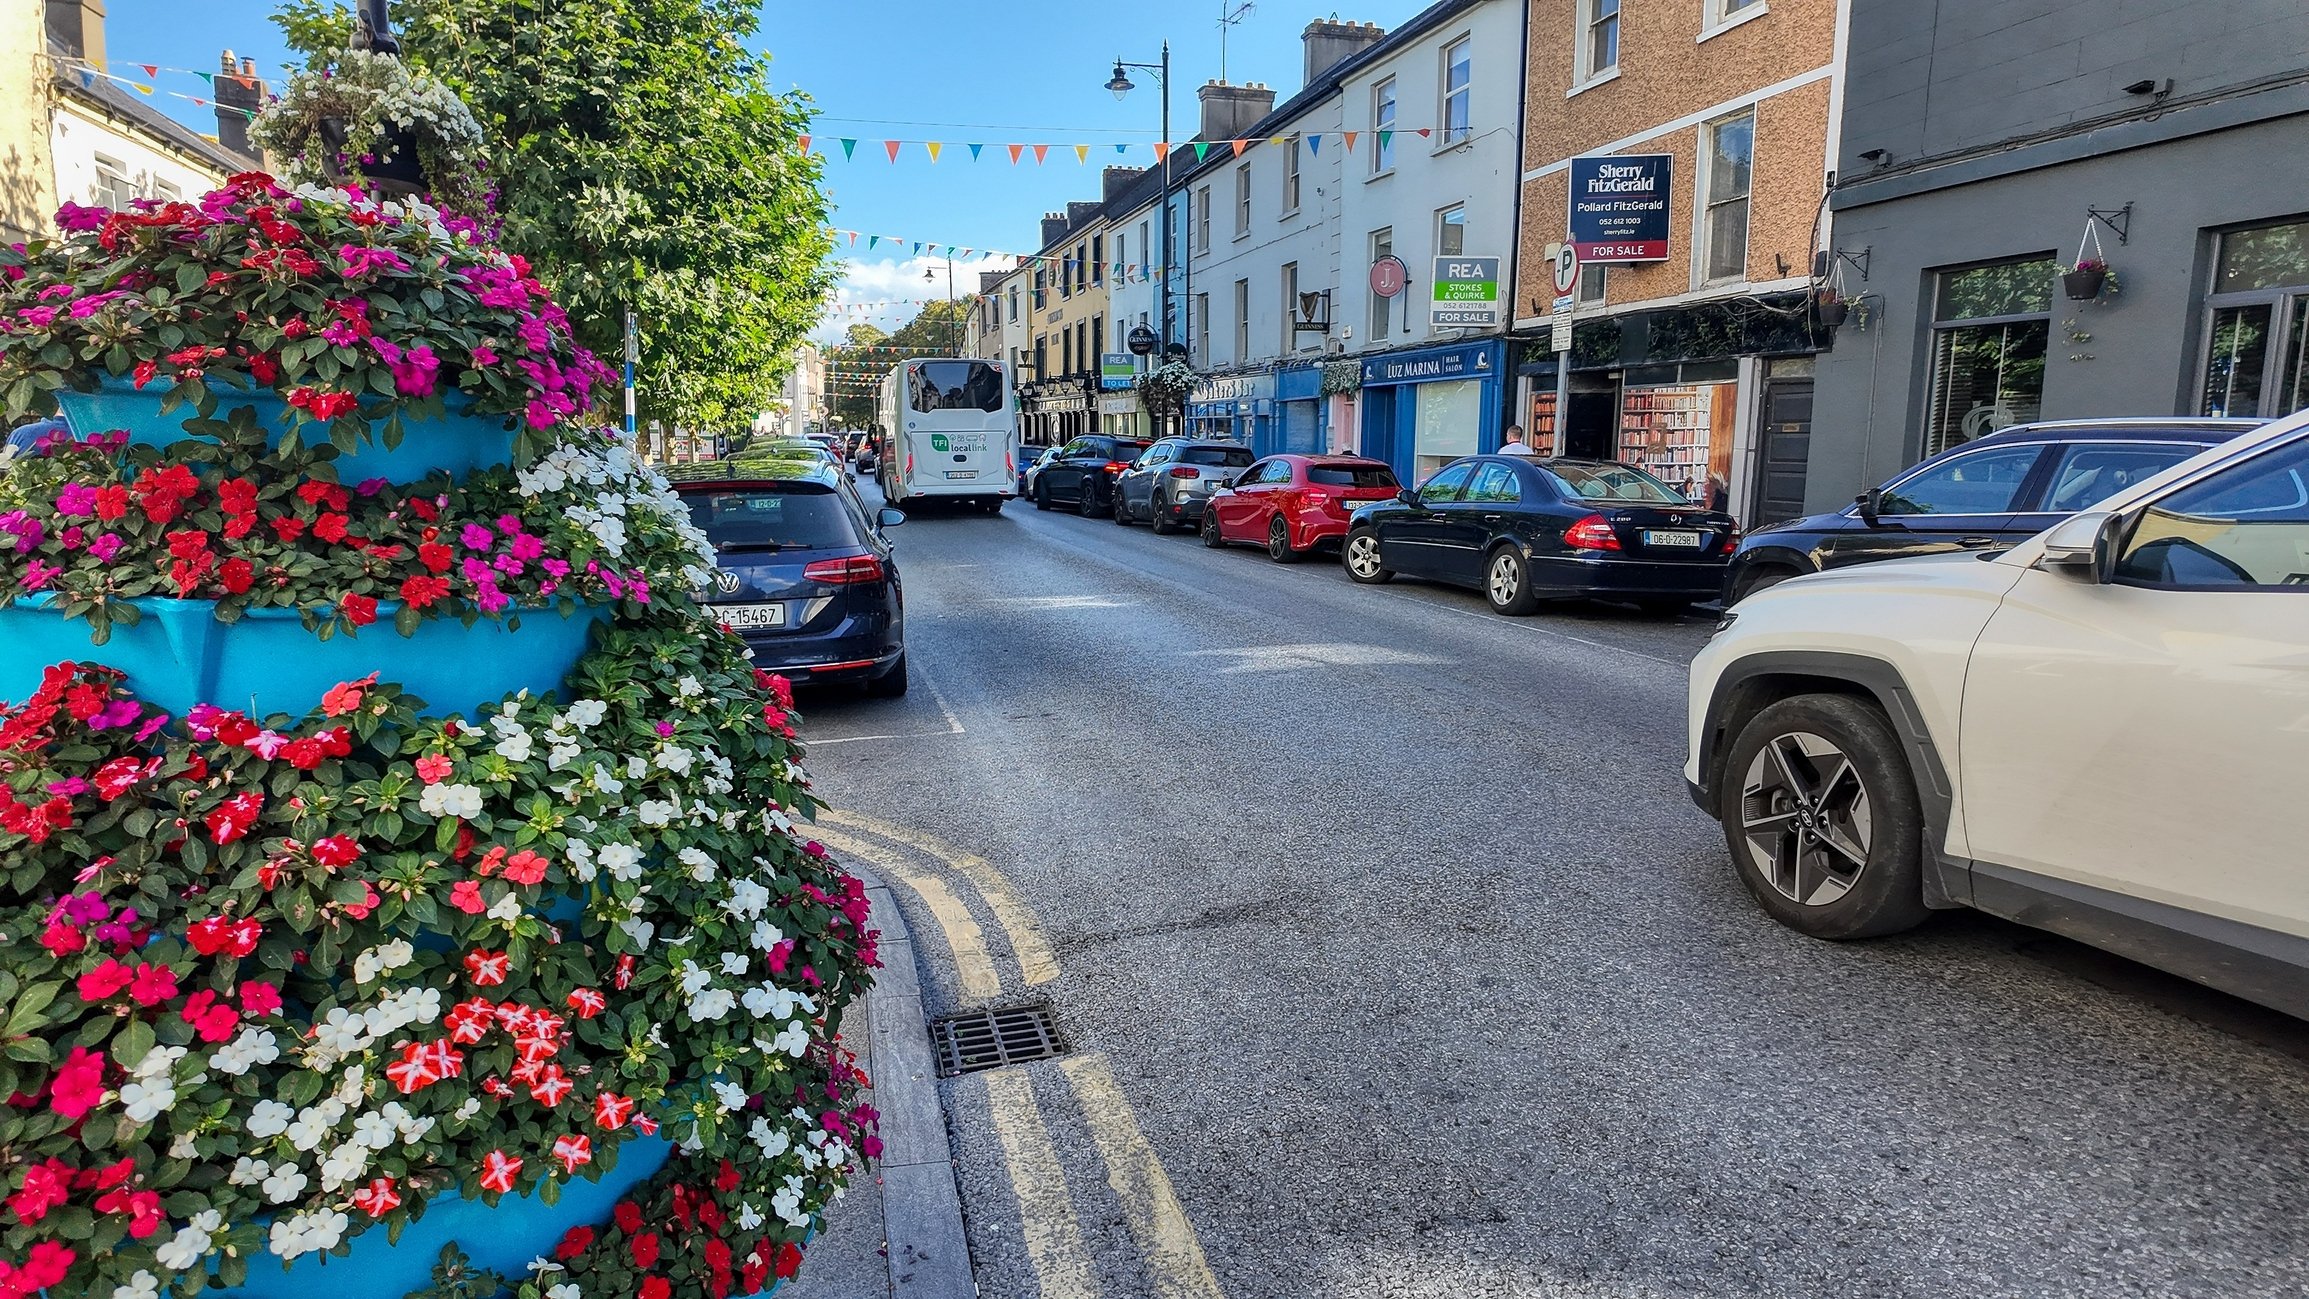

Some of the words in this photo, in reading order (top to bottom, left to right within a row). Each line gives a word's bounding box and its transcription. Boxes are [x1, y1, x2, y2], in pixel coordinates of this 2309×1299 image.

[1599, 164, 1643, 180] Sherry
[1588, 177, 1654, 192] FitzGerald
[1578, 202, 1611, 212] Pollard
[1614, 200, 1663, 211] FitzGerald
[1593, 246, 1614, 256] FOR
[1617, 245, 1644, 256] SALE
[1448, 263, 1484, 278] REA
[1453, 292, 1485, 300] QUIRKE
[1439, 313, 1460, 321] FOR
[1463, 313, 1489, 321] SALE
[1109, 356, 1127, 364] REA
[1446, 355, 1459, 363] HAIR
[1387, 363, 1402, 378] LUZ
[1404, 360, 1440, 376] MARINA
[1445, 364, 1462, 373] SALON
[933, 439, 947, 447] TFI
[951, 444, 971, 452] local
